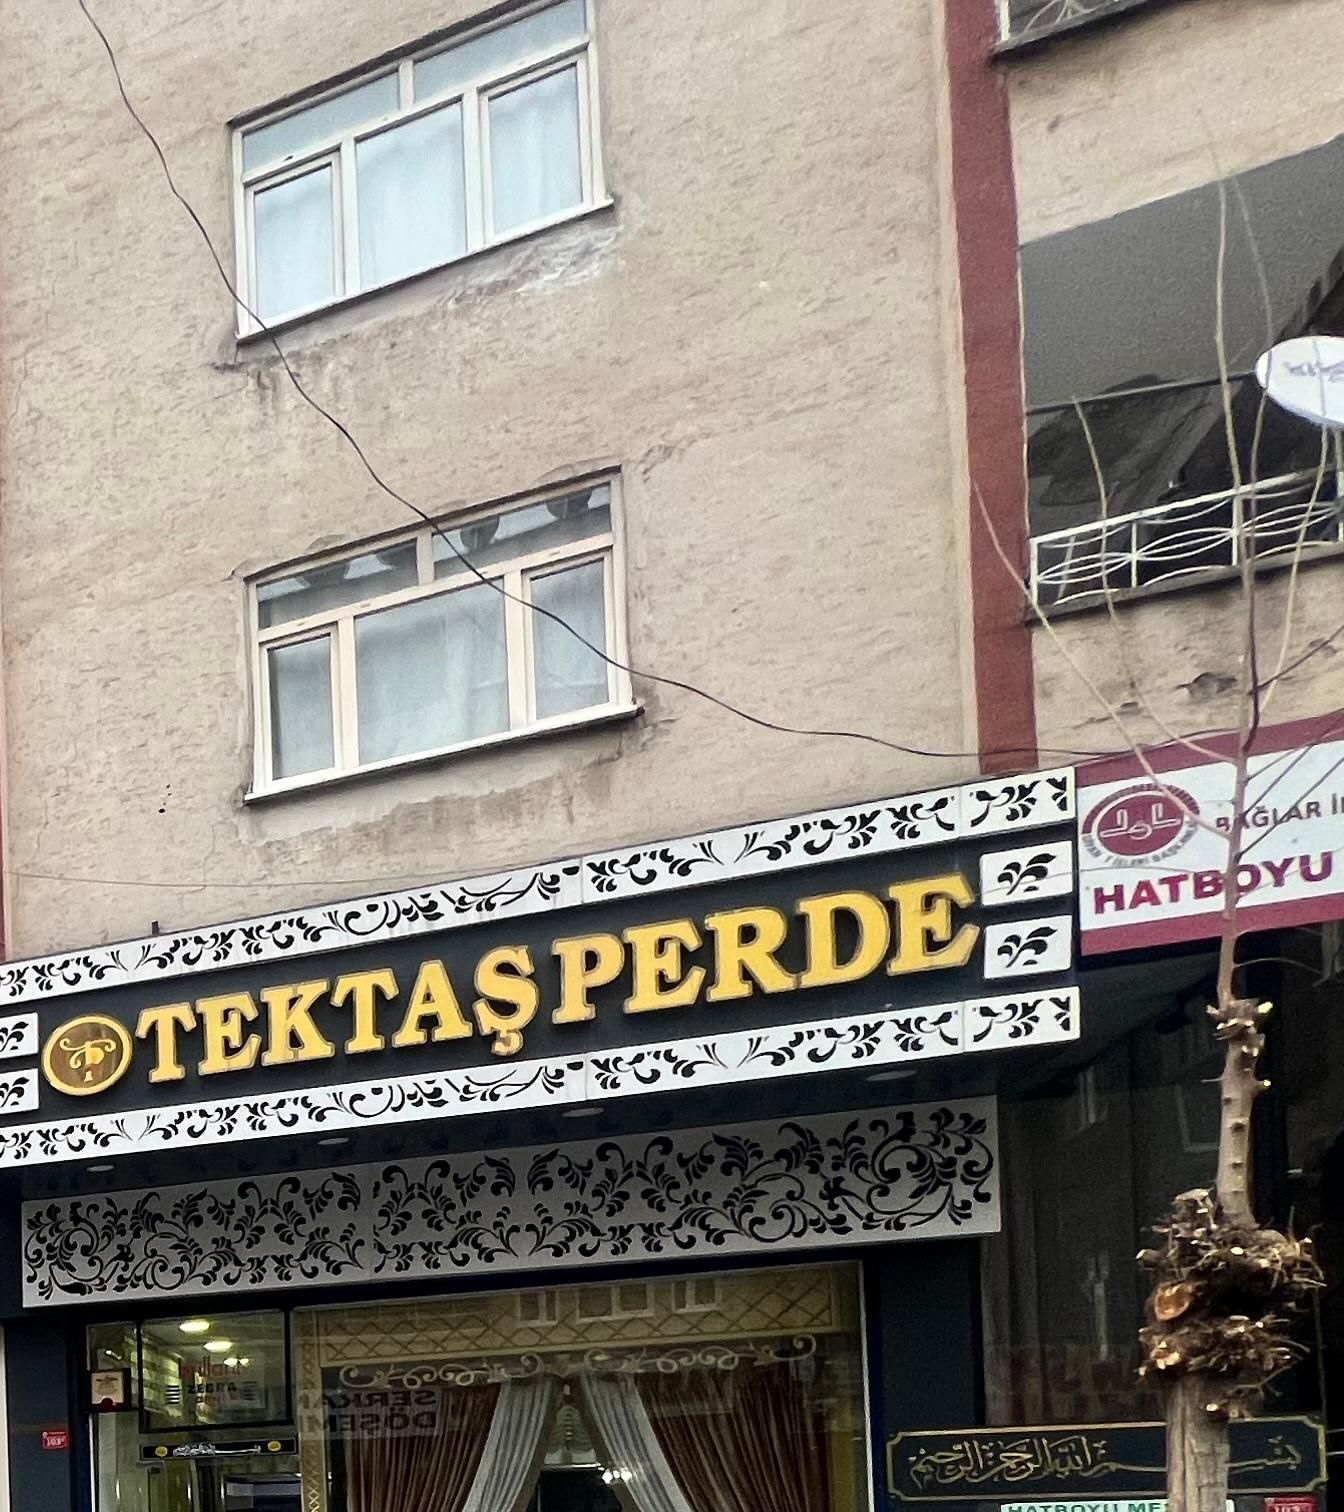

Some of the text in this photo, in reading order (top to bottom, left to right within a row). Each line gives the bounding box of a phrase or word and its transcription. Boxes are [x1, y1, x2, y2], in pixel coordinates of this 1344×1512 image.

[1094, 851, 1333, 915] HATBOYU
[134, 872, 981, 1083] TEKTAŞ PERDE
